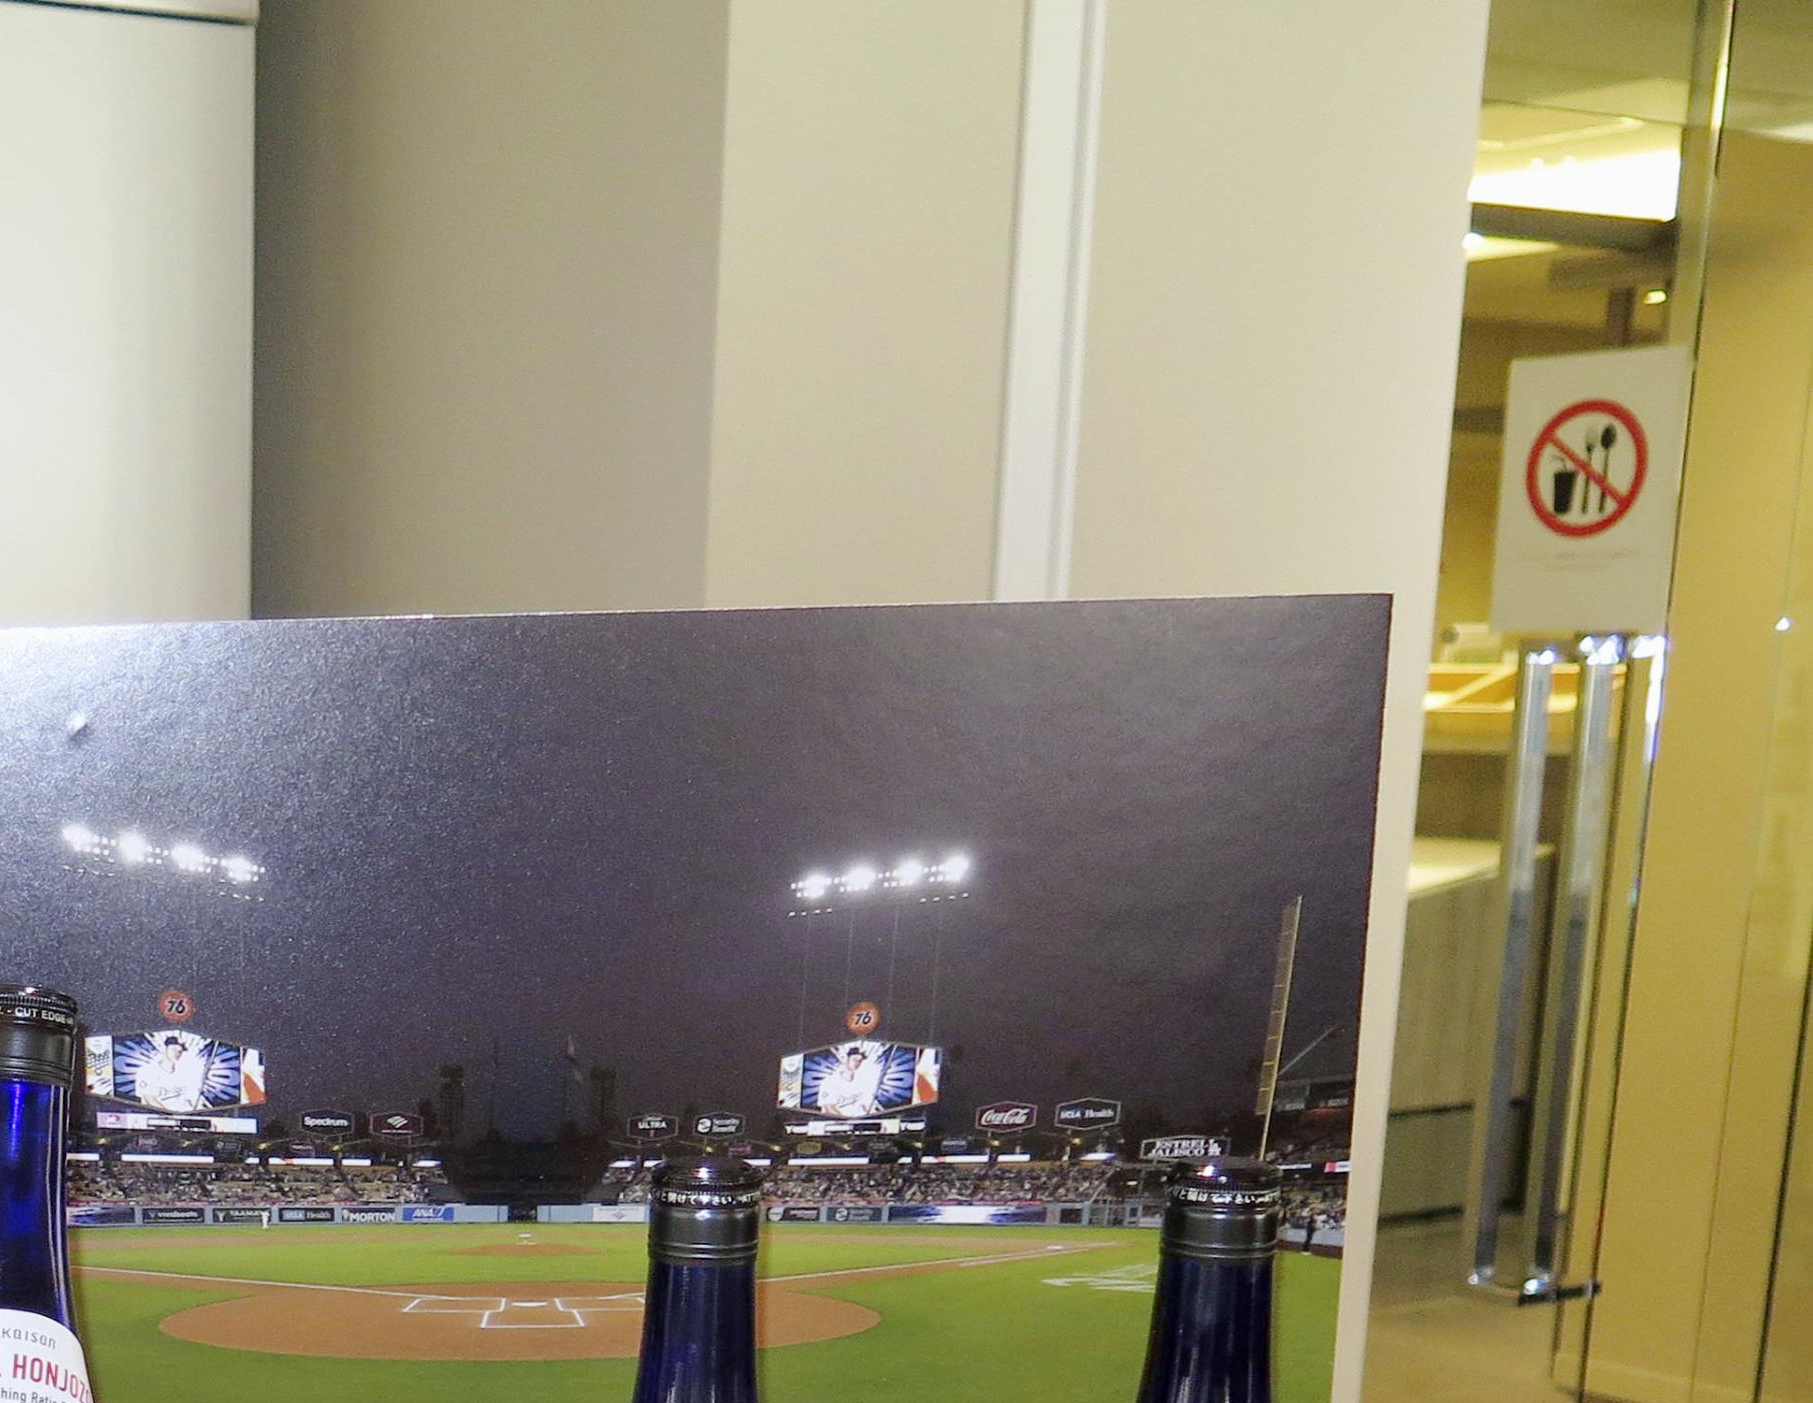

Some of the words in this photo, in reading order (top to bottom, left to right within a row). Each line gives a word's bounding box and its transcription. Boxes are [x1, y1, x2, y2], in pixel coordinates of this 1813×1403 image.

[15, 1007, 38, 1018] CUT
[167, 999, 186, 1014] 76
[854, 1010, 872, 1025] 76
[304, 1116, 349, 1128] Spectrum
[349, 1212, 395, 1222] MORTON
